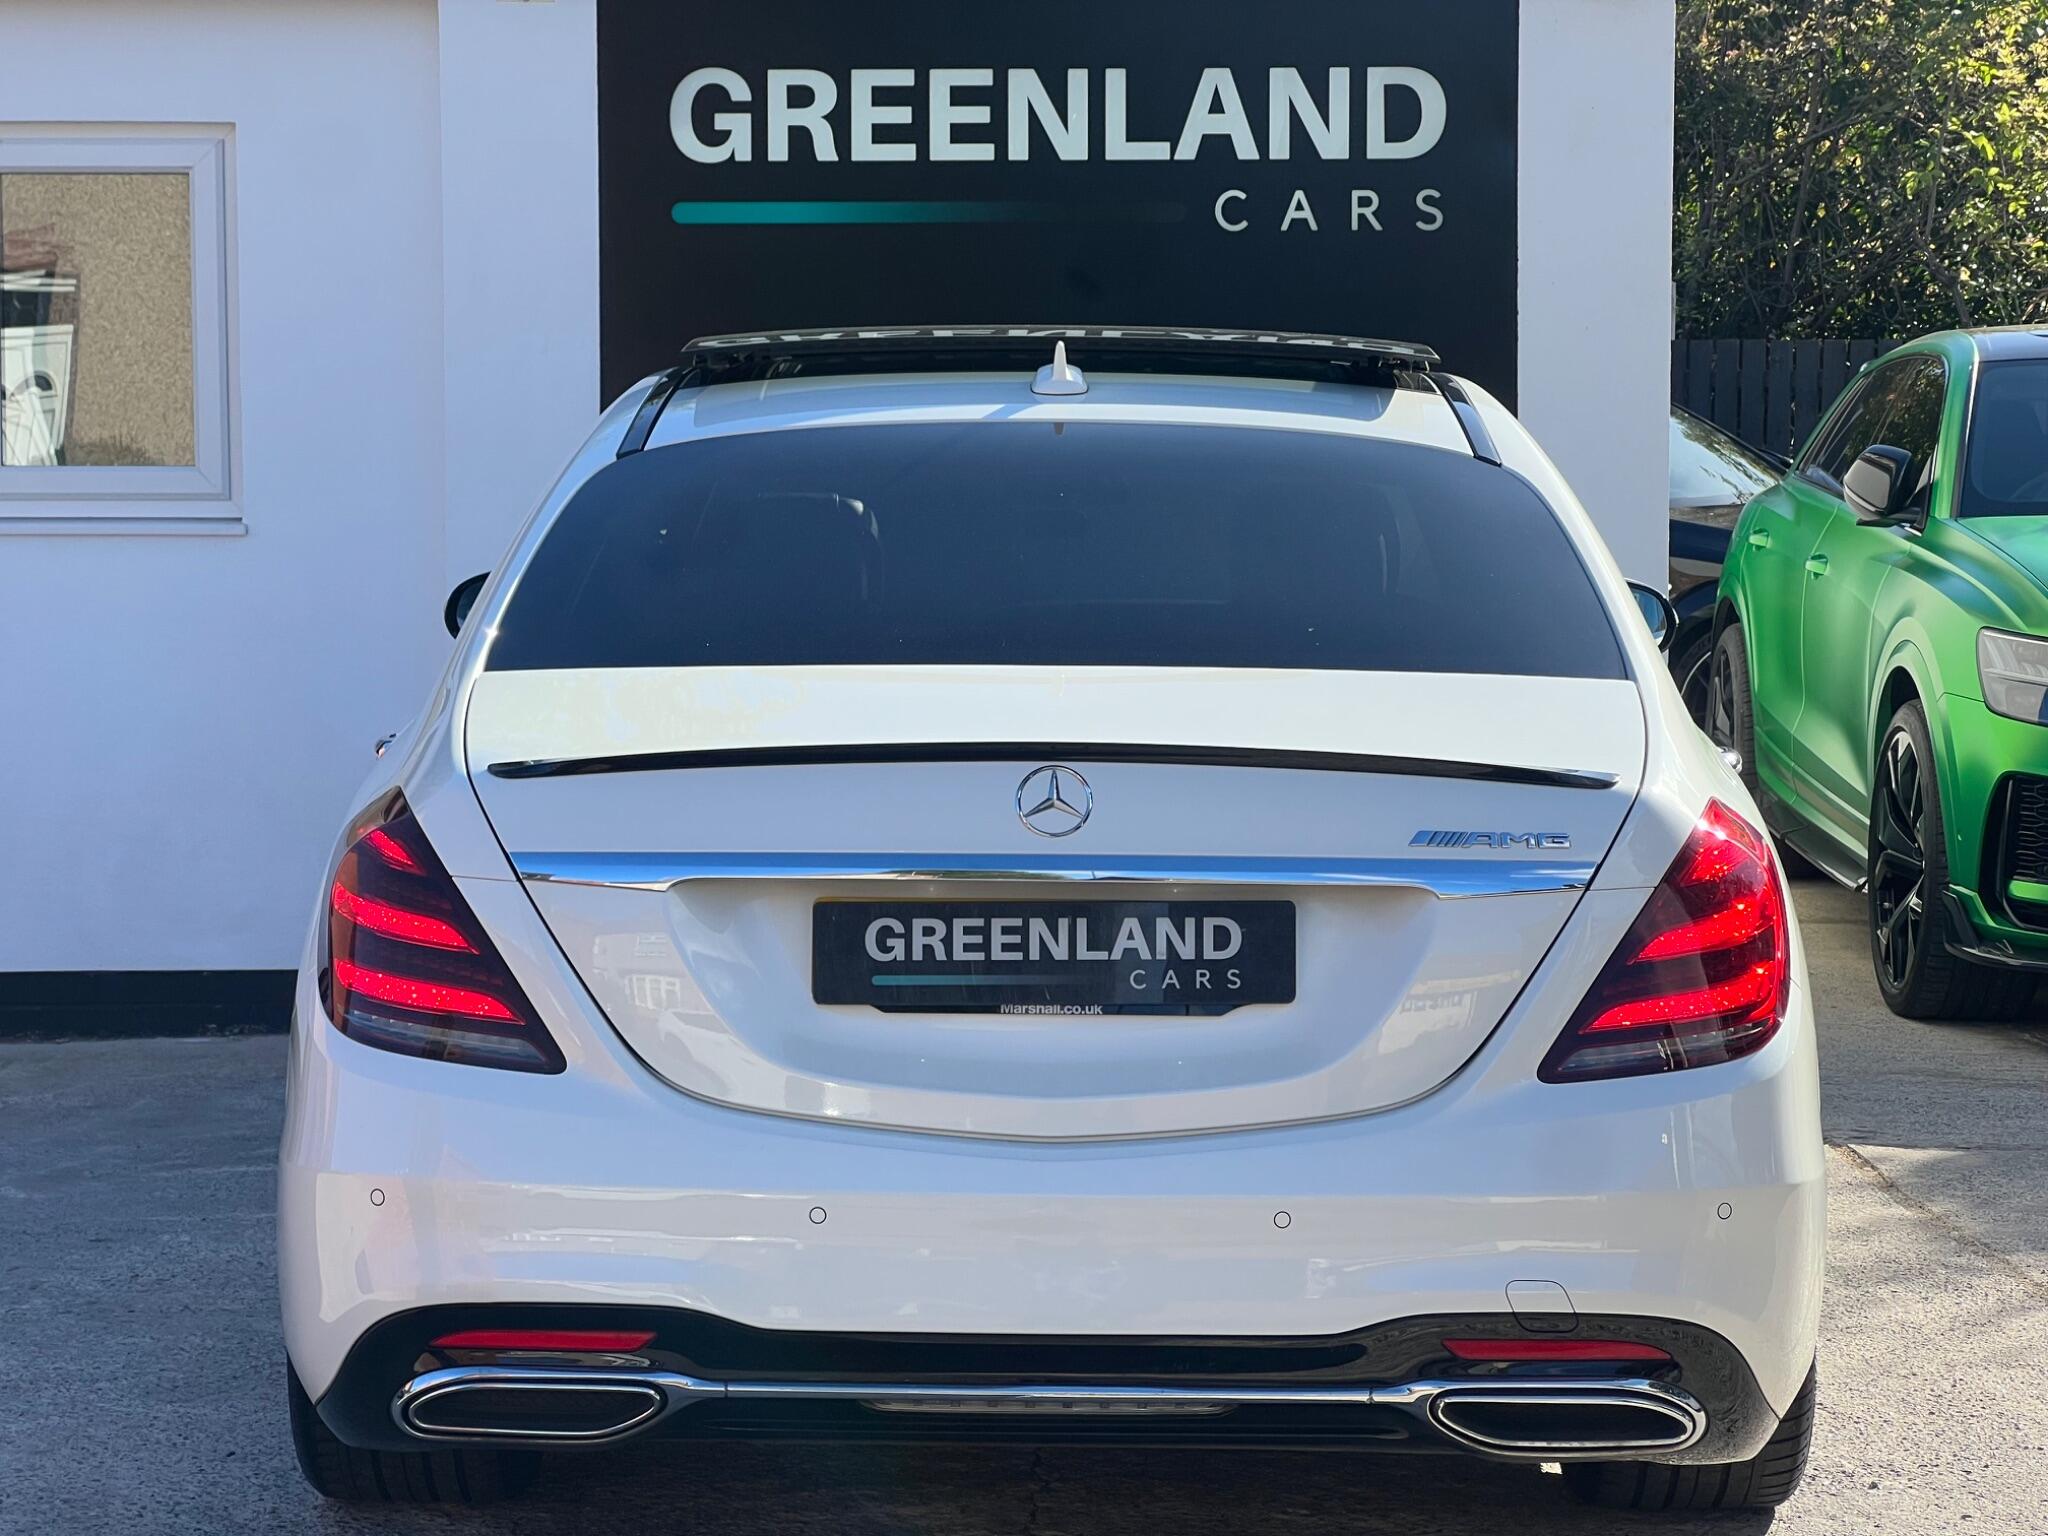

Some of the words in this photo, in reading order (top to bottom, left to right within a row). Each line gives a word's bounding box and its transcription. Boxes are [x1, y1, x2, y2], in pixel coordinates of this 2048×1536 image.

[669, 66, 1448, 164] GREENLAND
[1214, 188, 1444, 232] CARS
[1462, 831, 1571, 849] AMG
[864, 916, 1243, 962] GREENLAND
[1130, 968, 1242, 990] CARS
